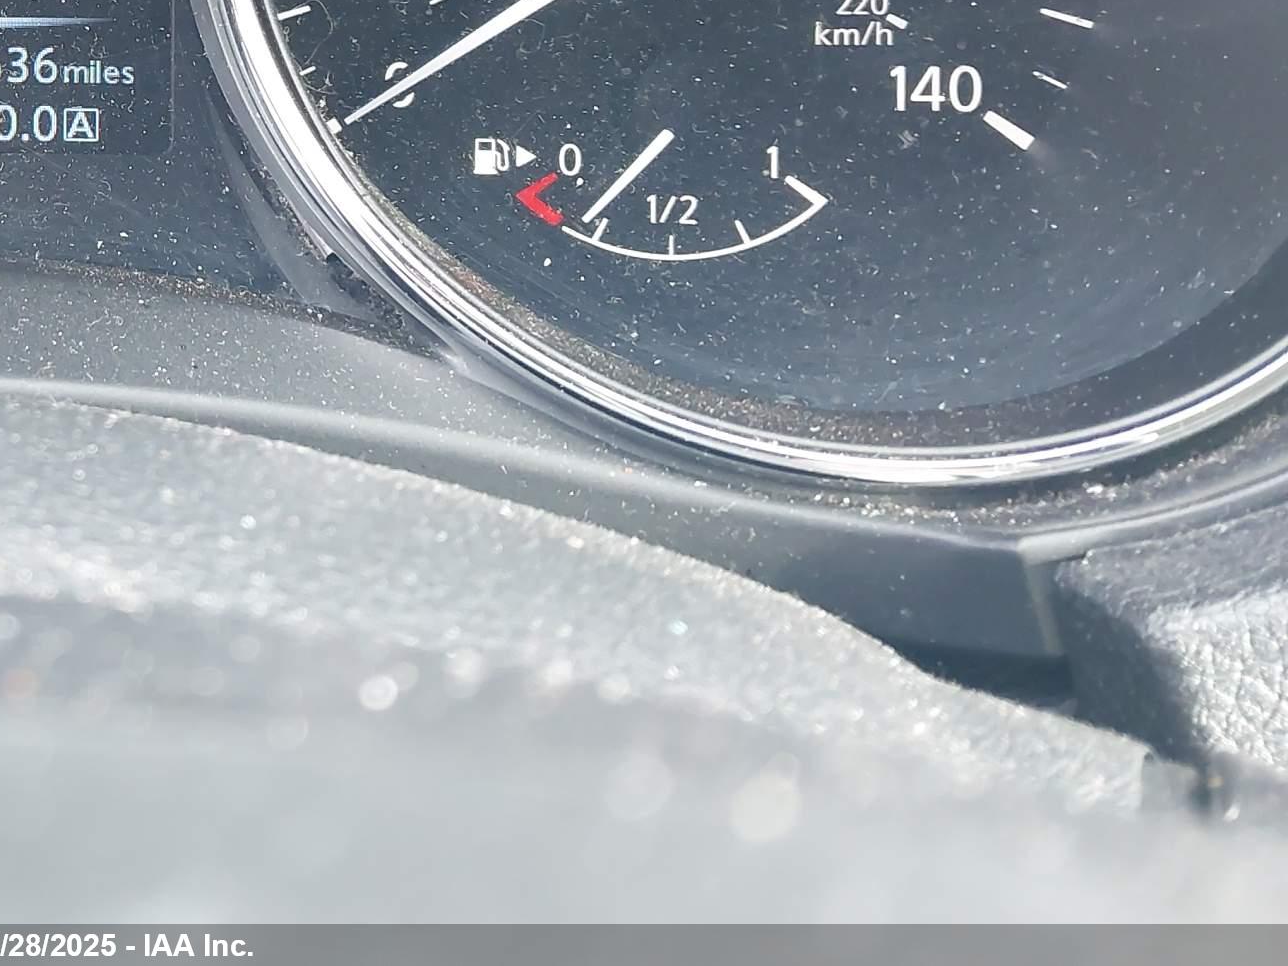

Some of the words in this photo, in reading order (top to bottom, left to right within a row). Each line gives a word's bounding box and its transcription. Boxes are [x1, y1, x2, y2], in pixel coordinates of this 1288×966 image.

[815, 21, 893, 45] km/h
[890, 65, 982, 112] 140
[559, 144, 581, 176] 0
[766, 146, 778, 178] 1
[647, 195, 698, 225] 1/2
